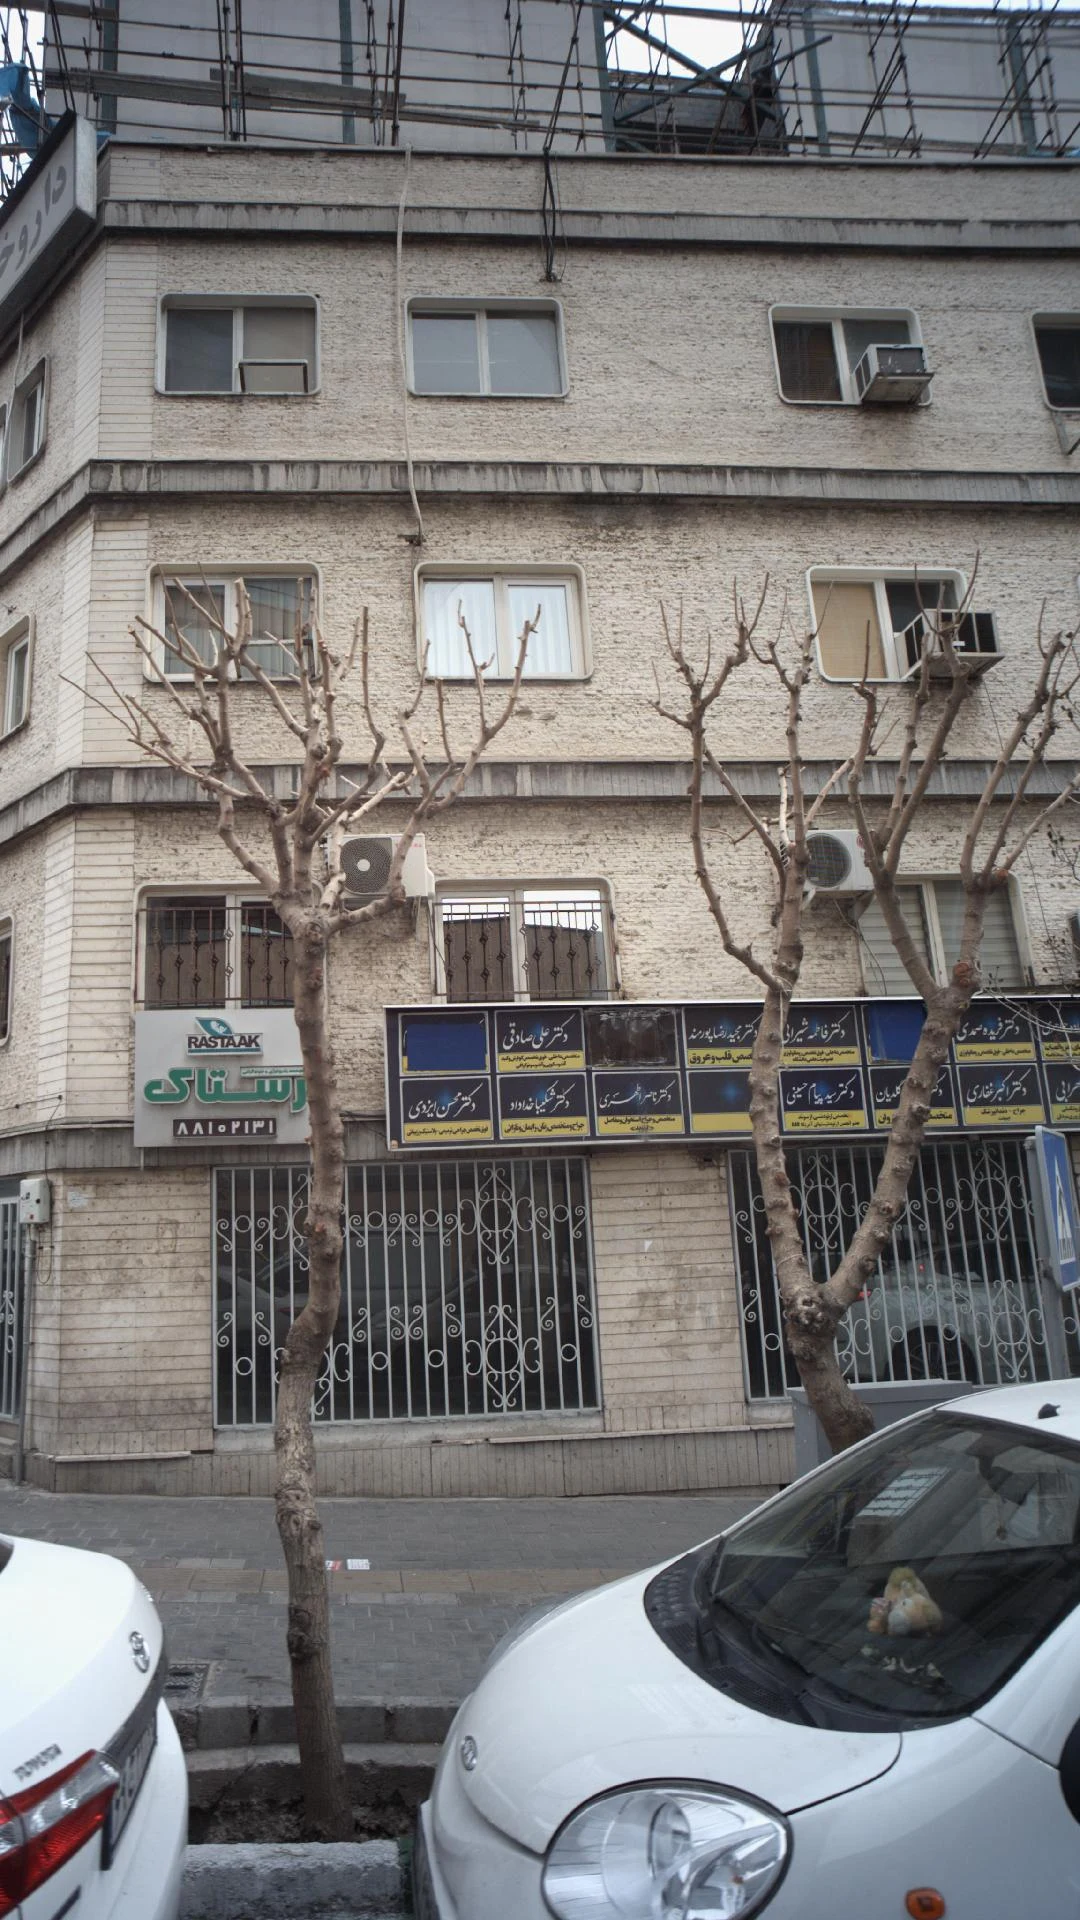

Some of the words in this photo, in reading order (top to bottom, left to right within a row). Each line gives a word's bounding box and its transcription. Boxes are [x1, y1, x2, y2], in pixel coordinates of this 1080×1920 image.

[0, 166, 67, 278] داروخ
[502, 1022, 534, 1050] صادقی
[532, 1026, 550, 1050] علی
[545, 1013, 577, 1048] دکتر
[739, 1012, 764, 1042] دکتر
[807, 1022, 829, 1039] فاطمه
[825, 1010, 851, 1043] دکتر
[983, 1017, 1003, 1040] فریده
[999, 1013, 1020, 1040] دکتر
[187, 1035, 260, 1049] RASTAAK
[690, 1053, 711, 1064] عروق
[715, 1050, 732, 1063] قلب
[145, 1068, 307, 1112] رستاک
[654, 1080, 676, 1105] دکتر
[787, 1082, 808, 1105] حسینی
[808, 1083, 824, 1105] پیام
[835, 1073, 857, 1103] دکتر
[967, 1083, 996, 1103] غفاری
[991, 1070, 1015, 1102] اکبر
[1007, 1068, 1031, 1101] دکتر
[408, 1099, 437, 1120] ایزدی
[436, 1092, 462, 1118] محسن
[453, 1082, 483, 1118] دکتر
[510, 1097, 535, 1111] خداداد
[550, 1082, 576, 1113] دکتر
[640, 1091, 657, 1104] ناصر
[824, 1092, 837, 1104] سید
[177, 1121, 273, 1135] ۸۸۱۰۲۱۳۱
